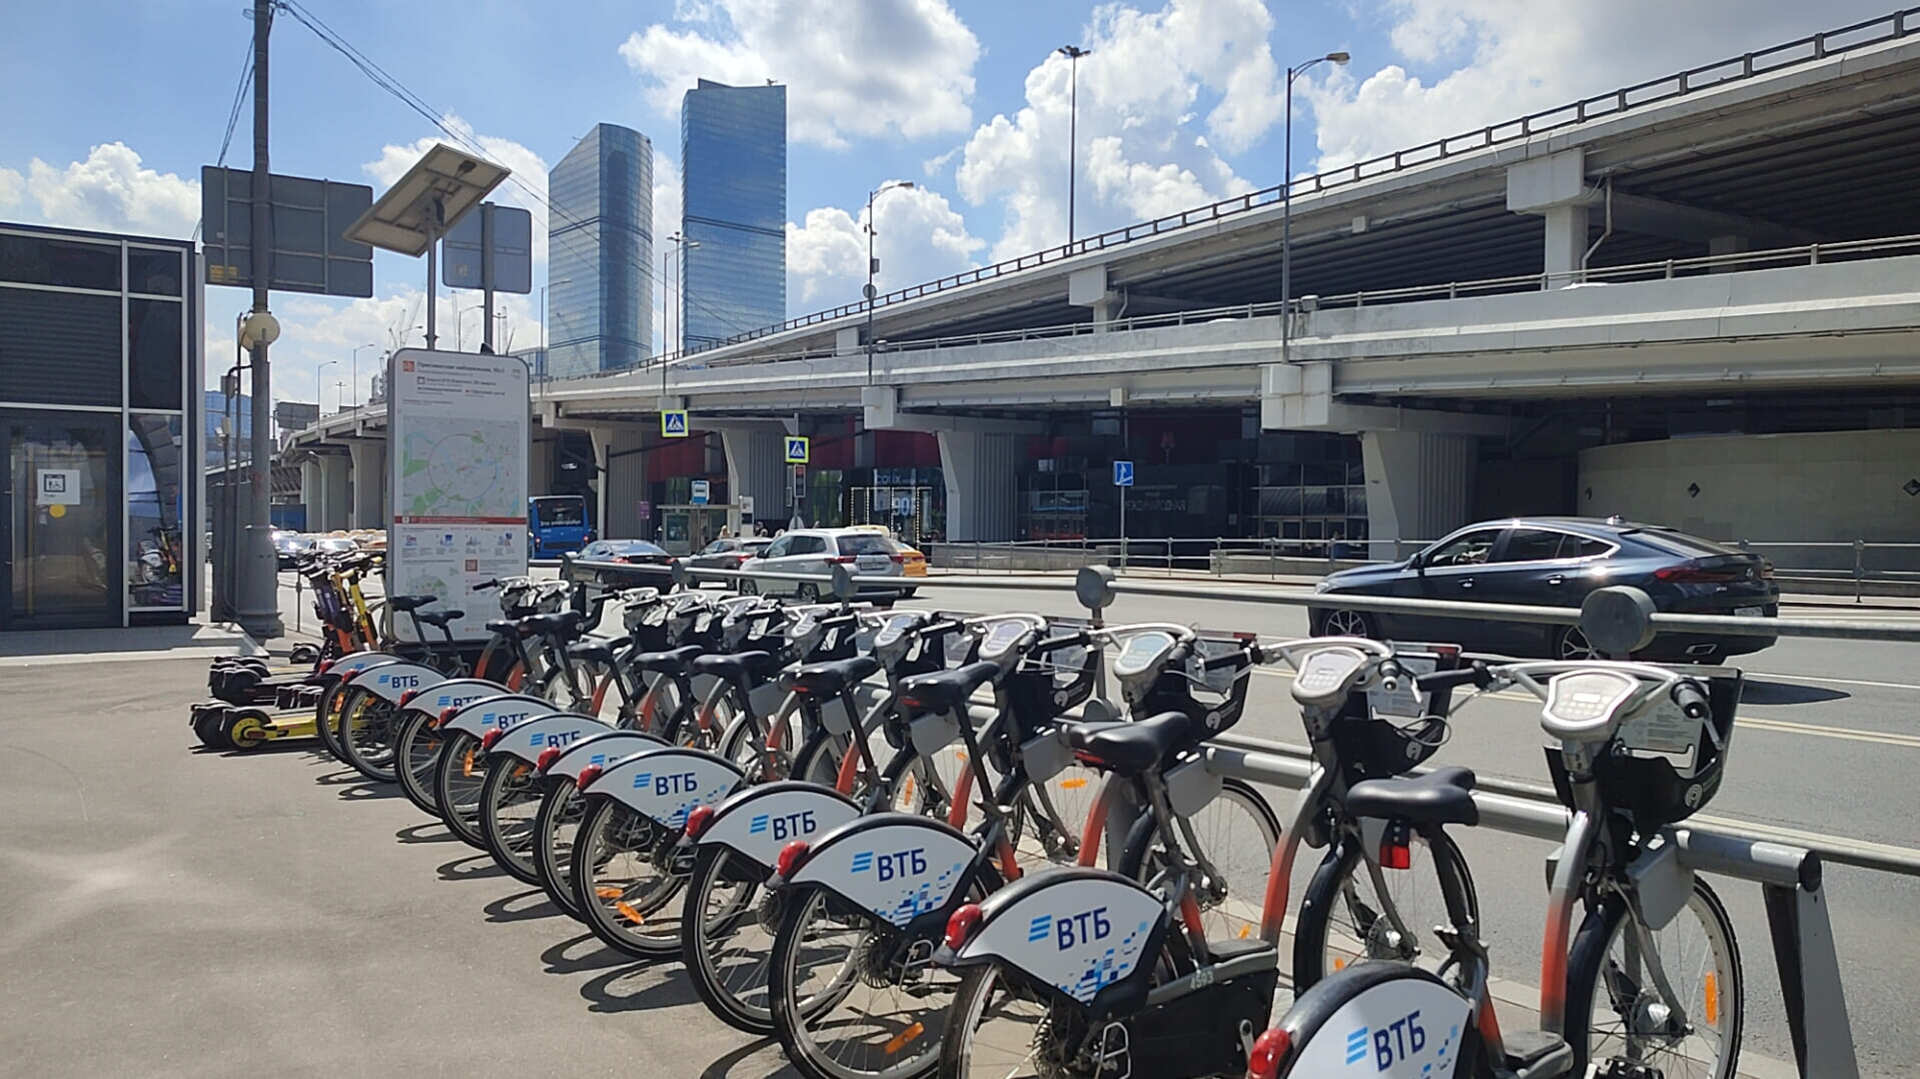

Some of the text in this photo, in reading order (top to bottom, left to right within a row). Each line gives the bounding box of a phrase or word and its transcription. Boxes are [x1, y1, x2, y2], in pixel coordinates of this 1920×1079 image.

[391, 676, 420, 689] ВТБ
[655, 773, 698, 796] ВТБ
[772, 810, 816, 841] ВТБ
[878, 848, 927, 881] ВТБ
[1057, 907, 1111, 950] ВТБ
[1373, 1010, 1426, 1072] ВТБ
